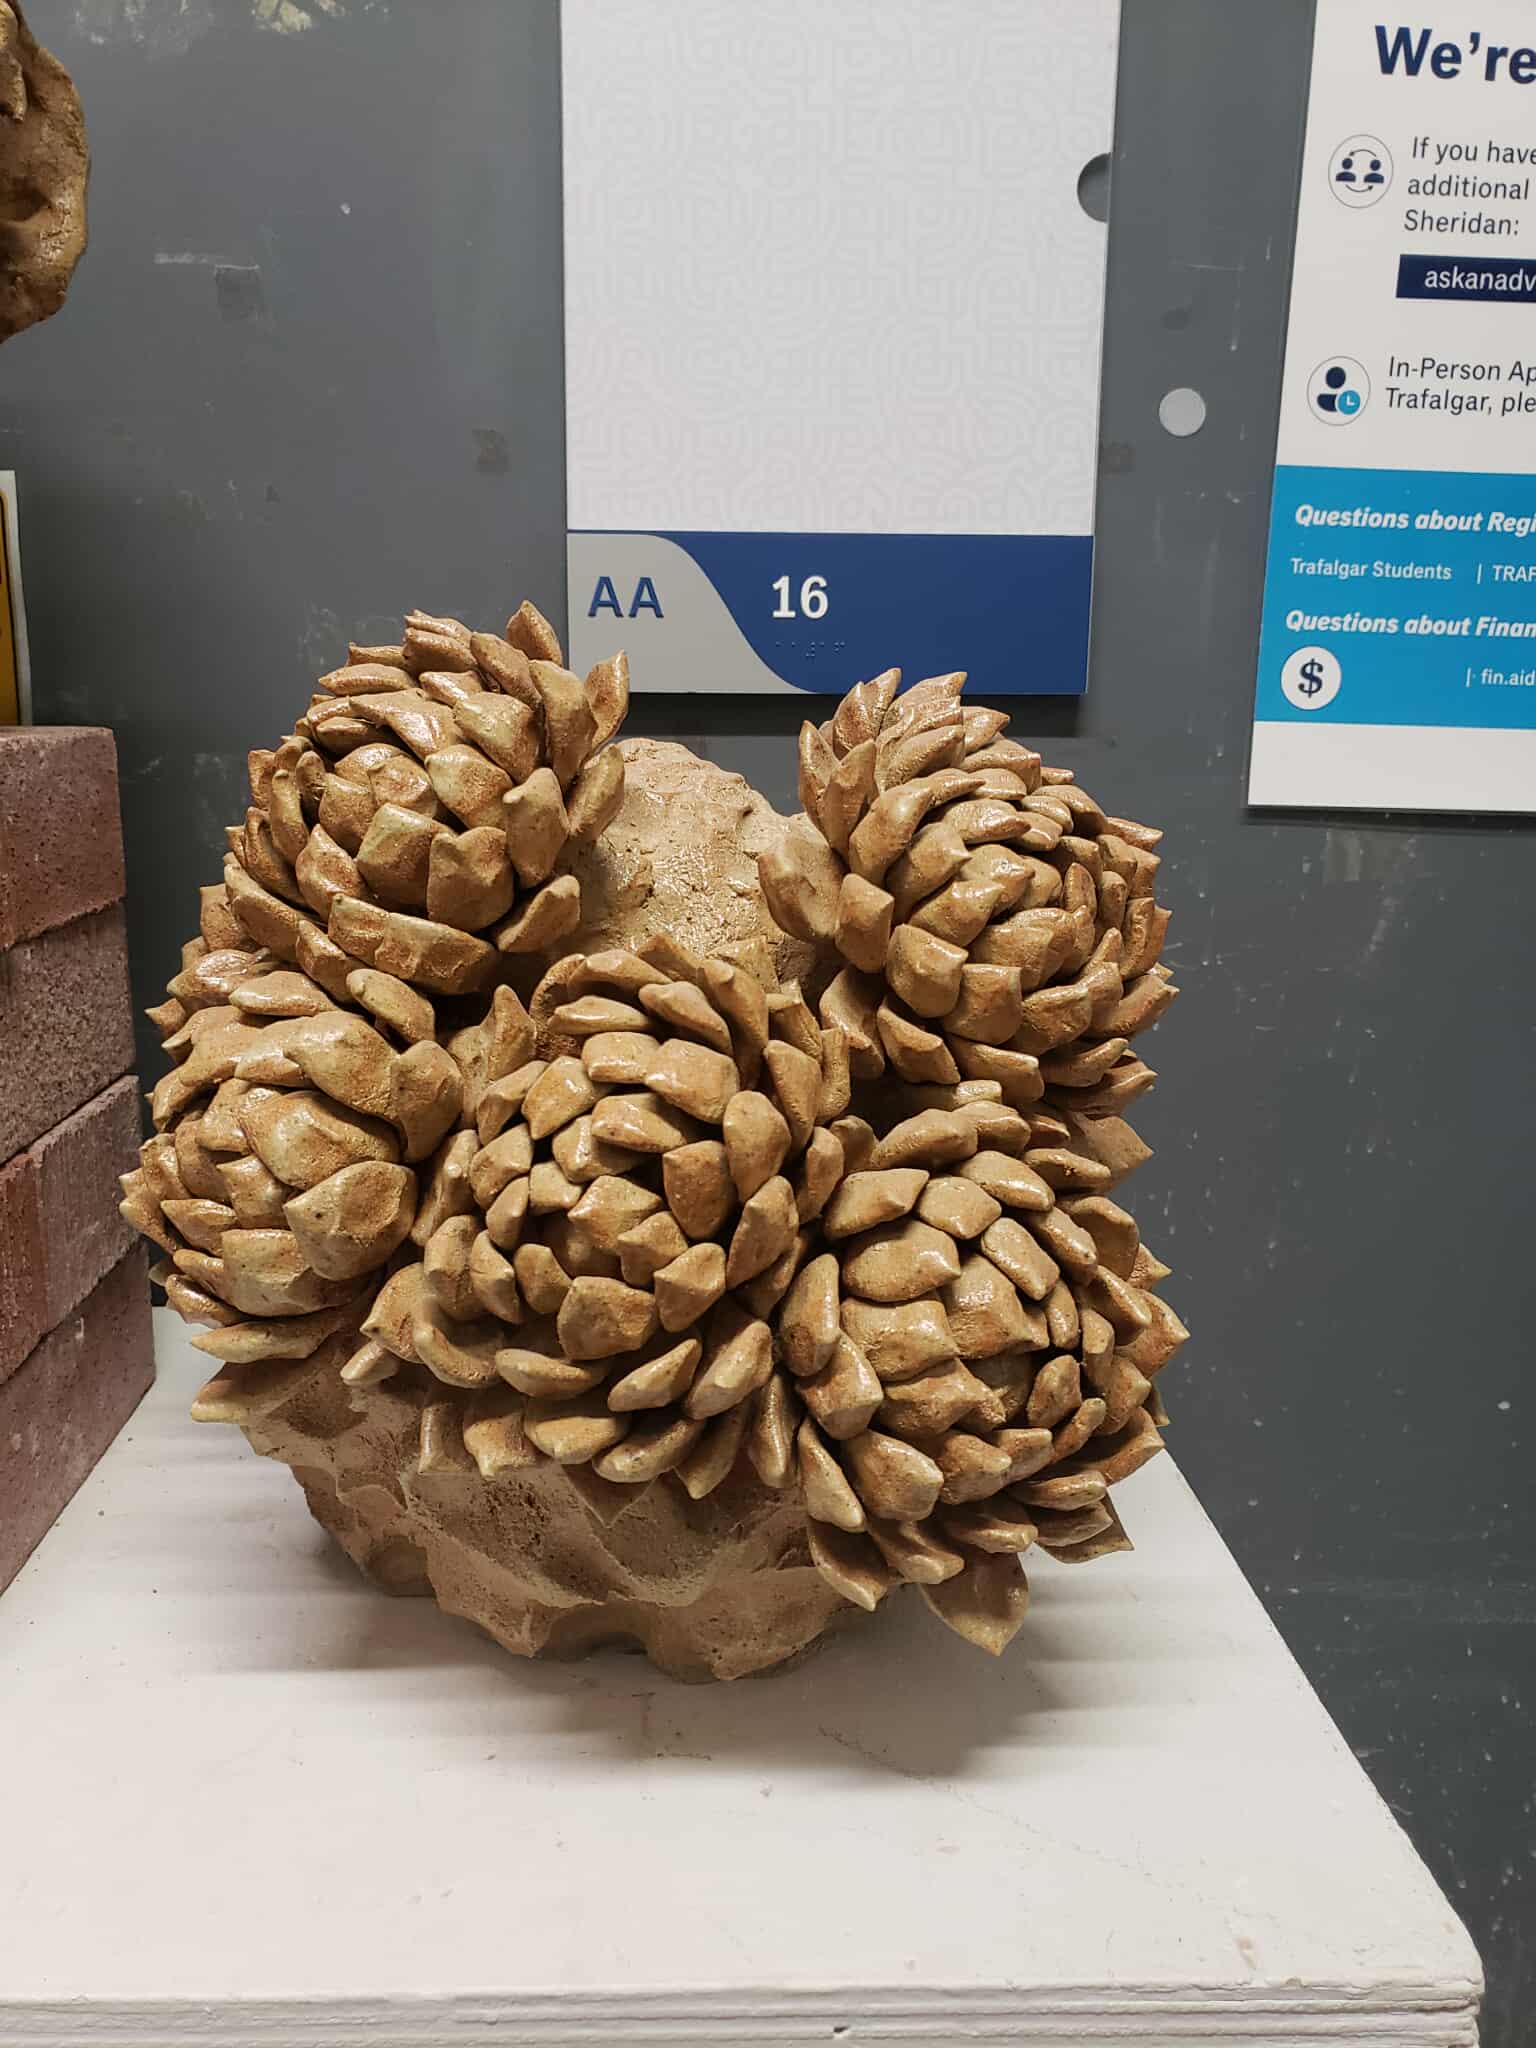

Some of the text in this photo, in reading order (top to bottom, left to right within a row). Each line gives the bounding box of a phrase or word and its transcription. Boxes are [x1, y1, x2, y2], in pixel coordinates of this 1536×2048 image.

[1375, 25, 1536, 84] We’re
[1412, 137, 1536, 165] If you have
[1408, 175, 1529, 200] additional
[1404, 209, 1519, 235] Sheridan:
[1389, 356, 1536, 386] In-Person Ap
[1386, 387, 1536, 416] Trafalgar, ple
[1295, 504, 1409, 529] Questions
[1415, 510, 1482, 531] about
[1291, 558, 1367, 580] Trafalgar
[1372, 561, 1452, 580] Students
[588, 576, 665, 618] AA
[772, 576, 829, 618] 16
[1286, 610, 1398, 633] Questions
[1404, 615, 1471, 636] about
